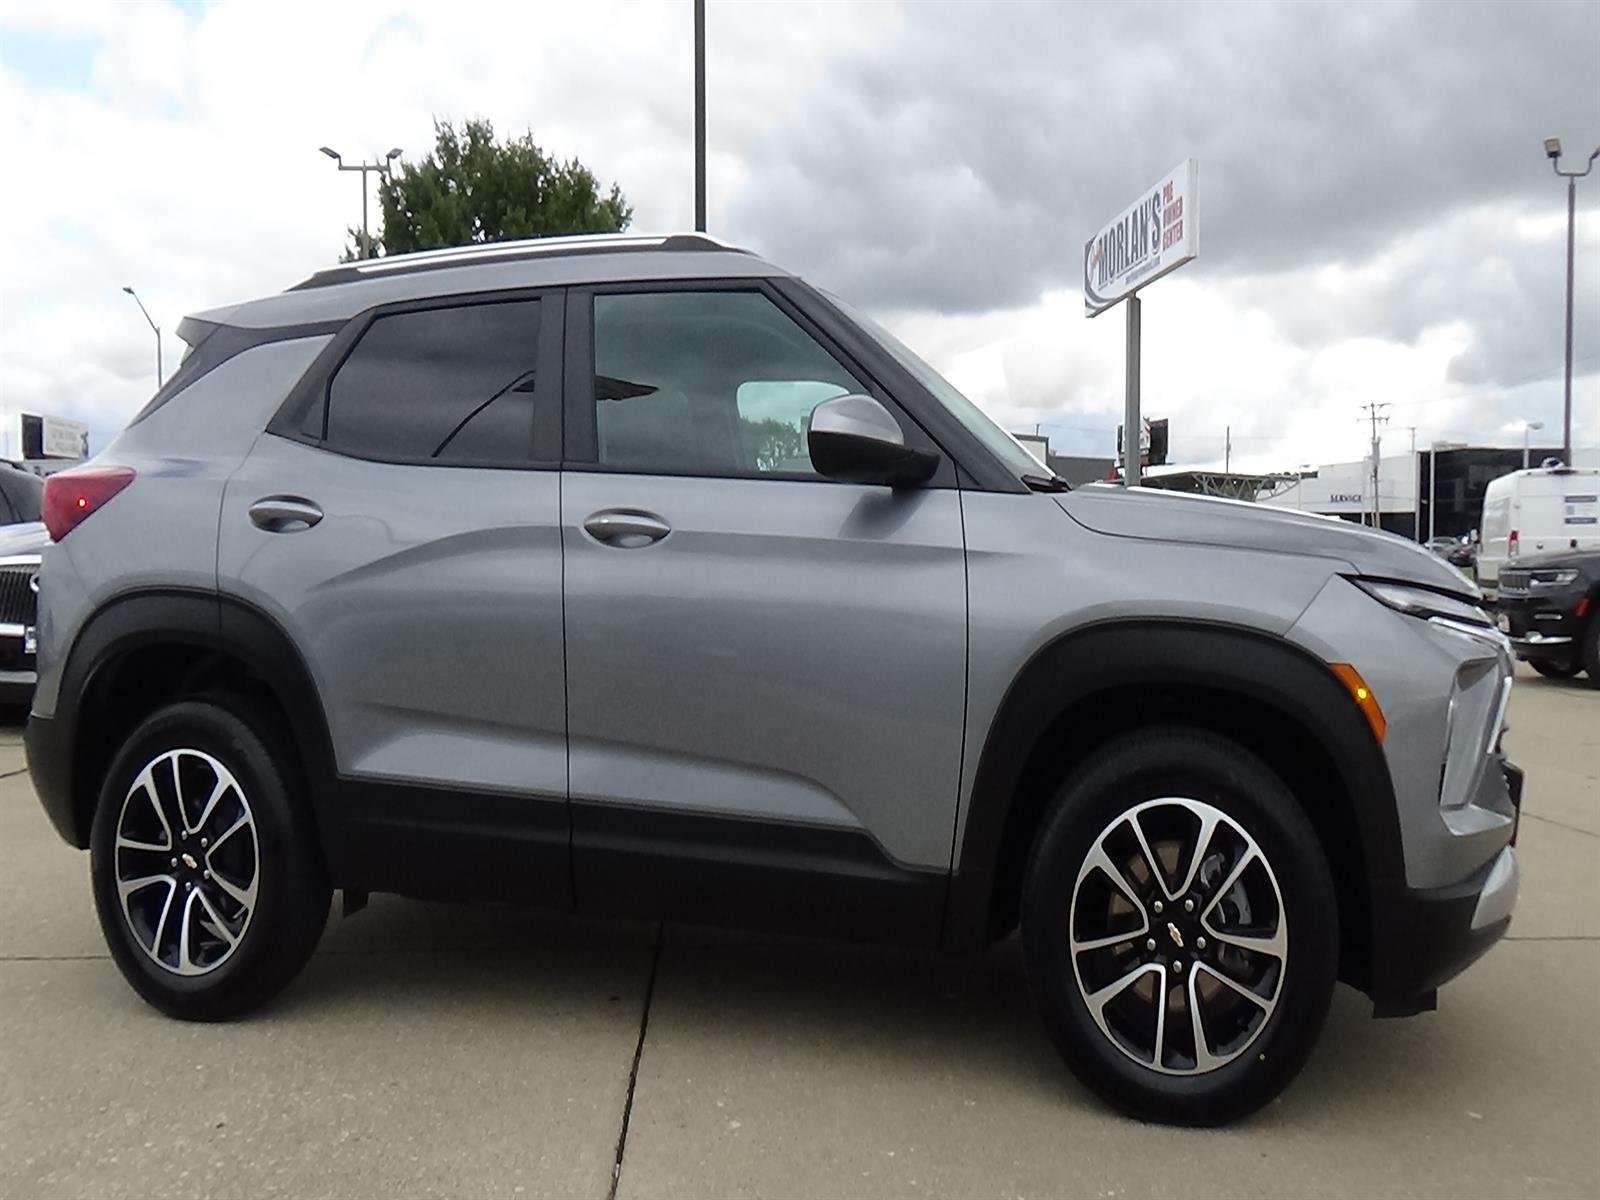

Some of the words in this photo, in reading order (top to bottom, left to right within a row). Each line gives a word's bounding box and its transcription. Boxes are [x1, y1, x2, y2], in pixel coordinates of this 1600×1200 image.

[1098, 191, 1162, 286] MORLAN'S
[1163, 219, 1183, 251] CENTER
[1330, 494, 1362, 503] SERVICE
